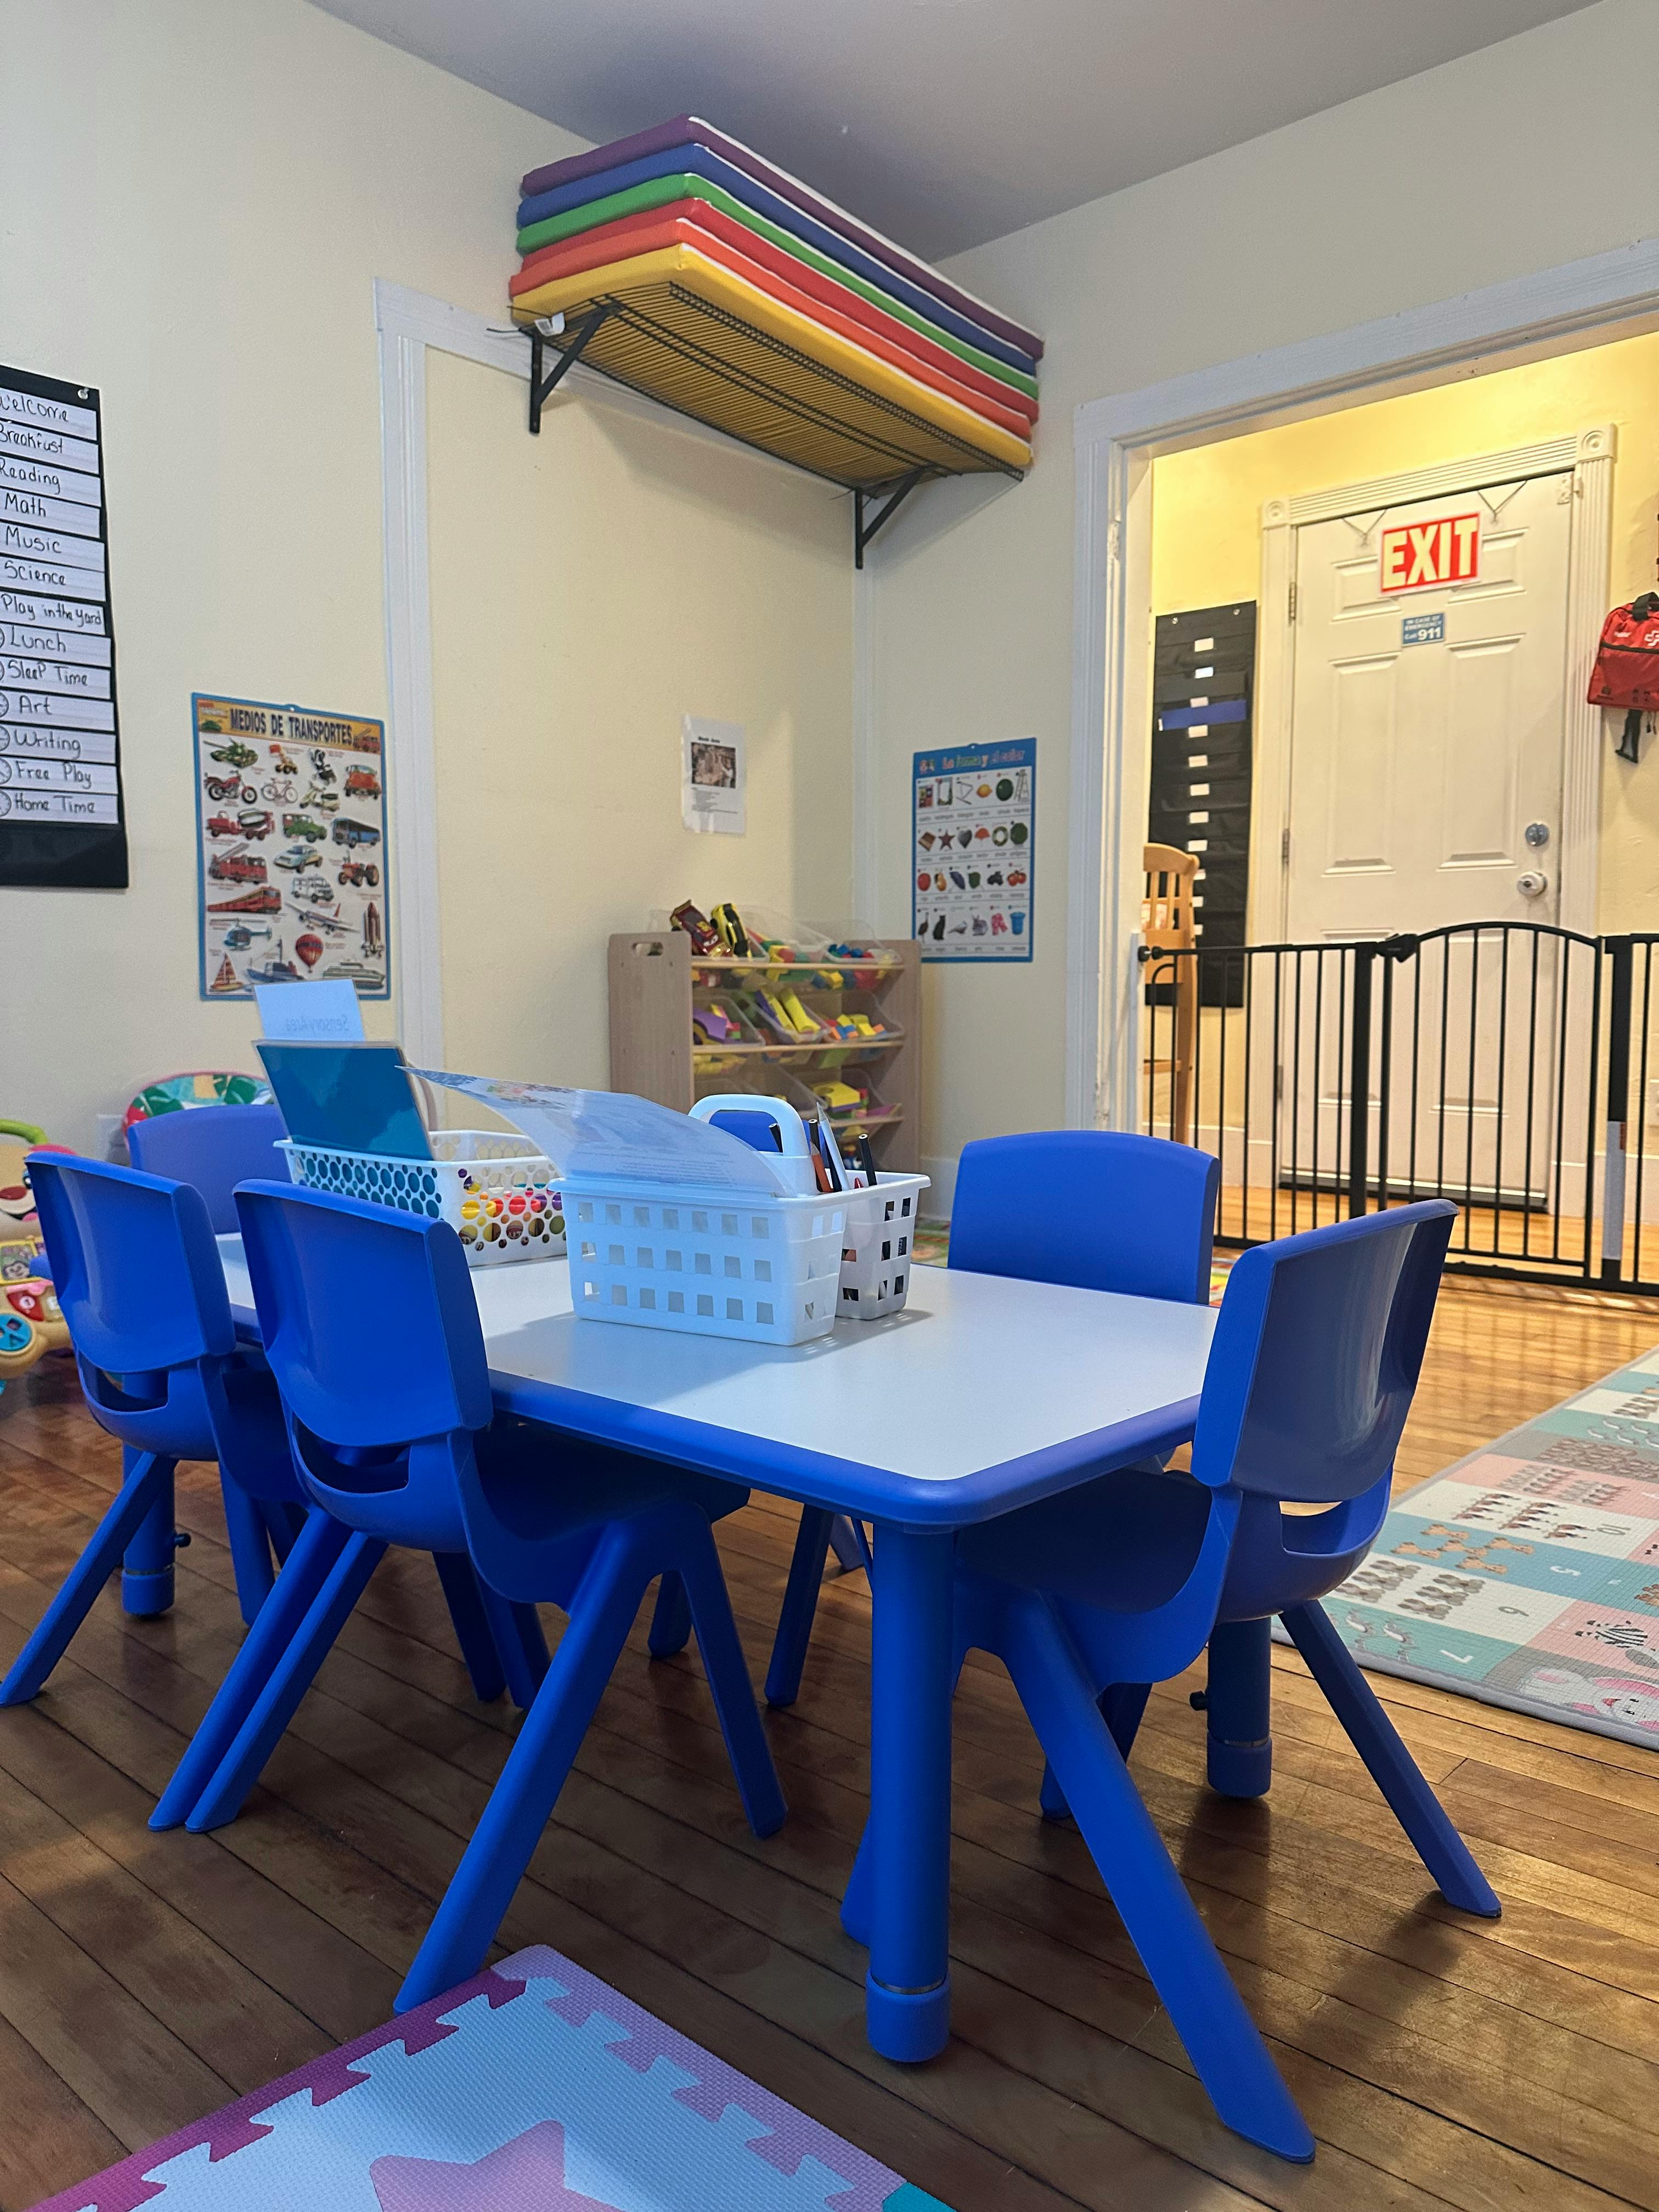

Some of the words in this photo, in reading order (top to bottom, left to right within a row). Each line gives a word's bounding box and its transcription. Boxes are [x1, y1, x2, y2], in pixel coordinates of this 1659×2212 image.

[4, 492, 47, 518] Math
[5, 525, 61, 554] Music
[1383, 517, 1478, 588] EXIT
[4, 560, 66, 585] Science
[1, 593, 35, 620] Play
[10, 625, 66, 653] Lunch
[1418, 627, 1441, 641] 911
[53, 665, 88, 686] Time
[20, 695, 53, 715] Art
[230, 708, 267, 734] MEDIOS
[271, 714, 284, 736] DE
[289, 715, 353, 745] TRANSPORTES
[14, 729, 81, 760] Writing
[15, 760, 50, 780] Free
[63, 761, 92, 789] Play
[15, 792, 49, 811] Home
[53, 795, 95, 814] Time
